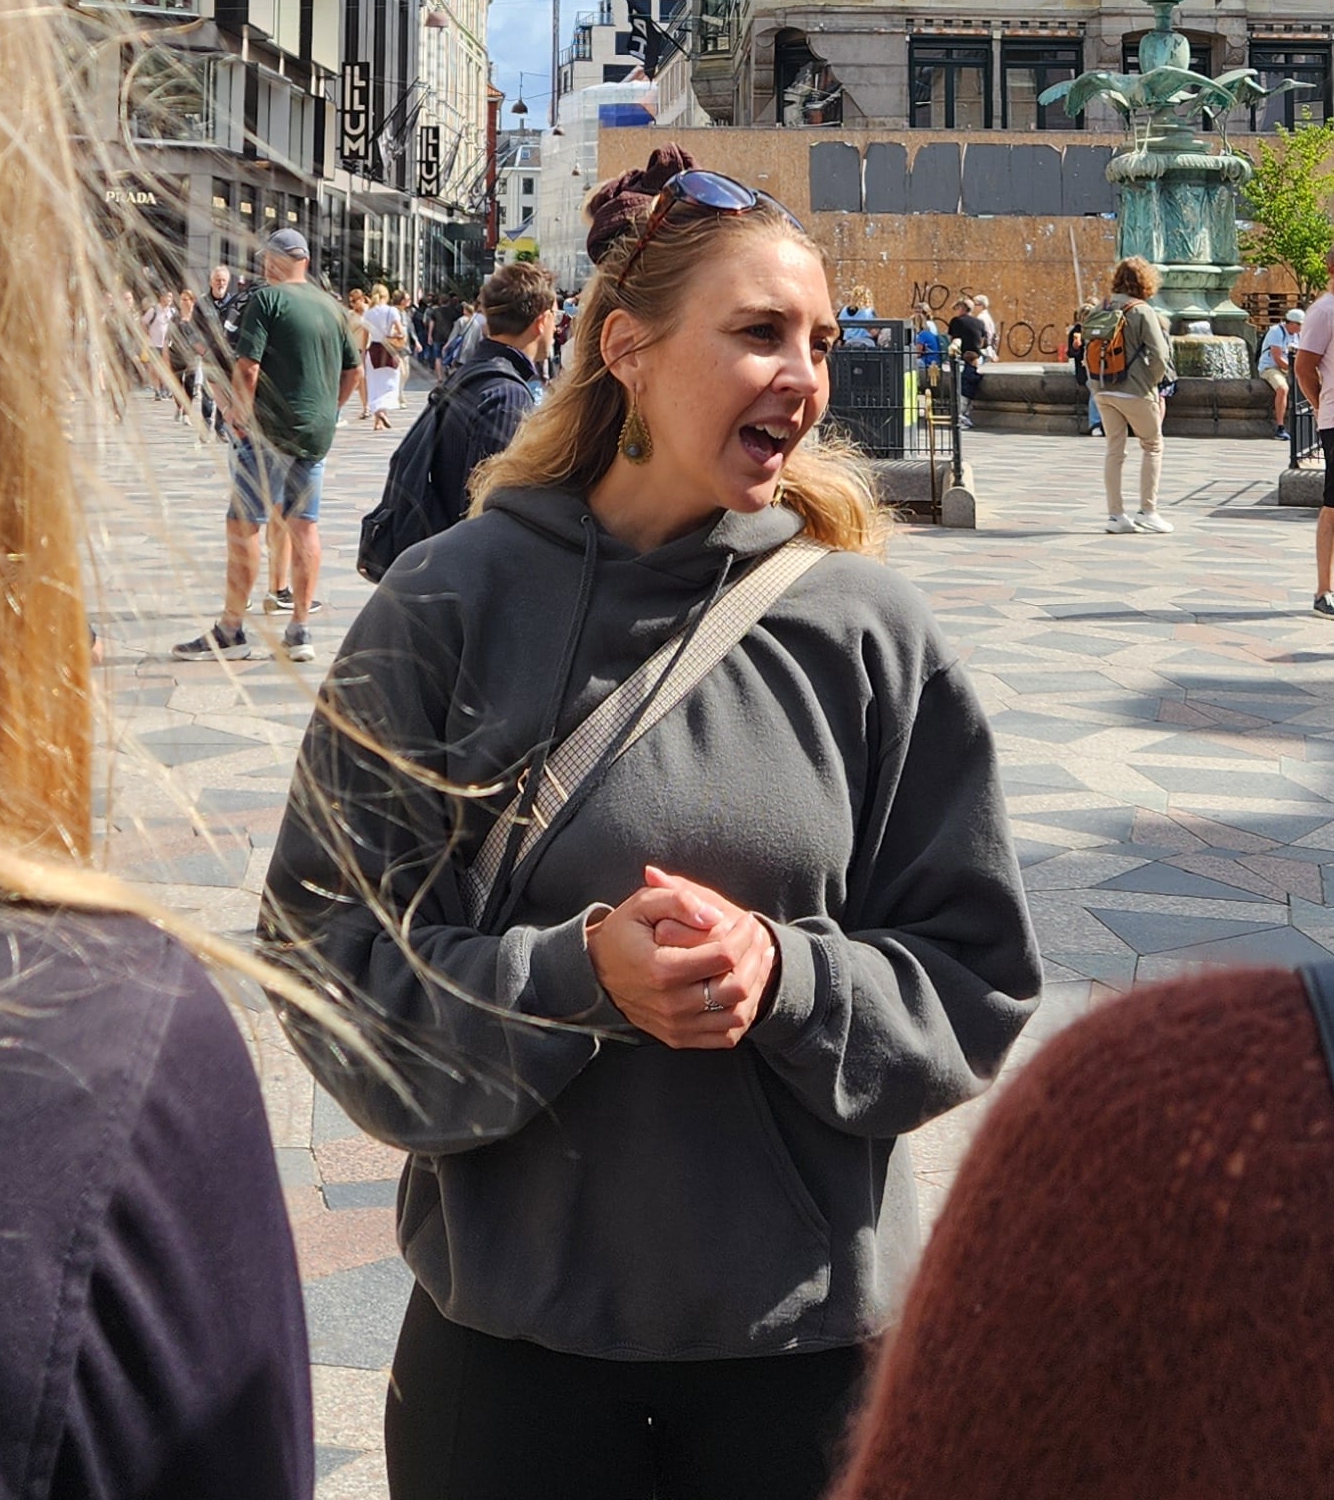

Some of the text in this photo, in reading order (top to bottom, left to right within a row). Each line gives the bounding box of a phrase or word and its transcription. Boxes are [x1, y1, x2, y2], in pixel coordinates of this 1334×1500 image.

[343, 65, 366, 157] ILLUM
[421, 128, 437, 195] ILLUM
[911, 281, 950, 310] NO
